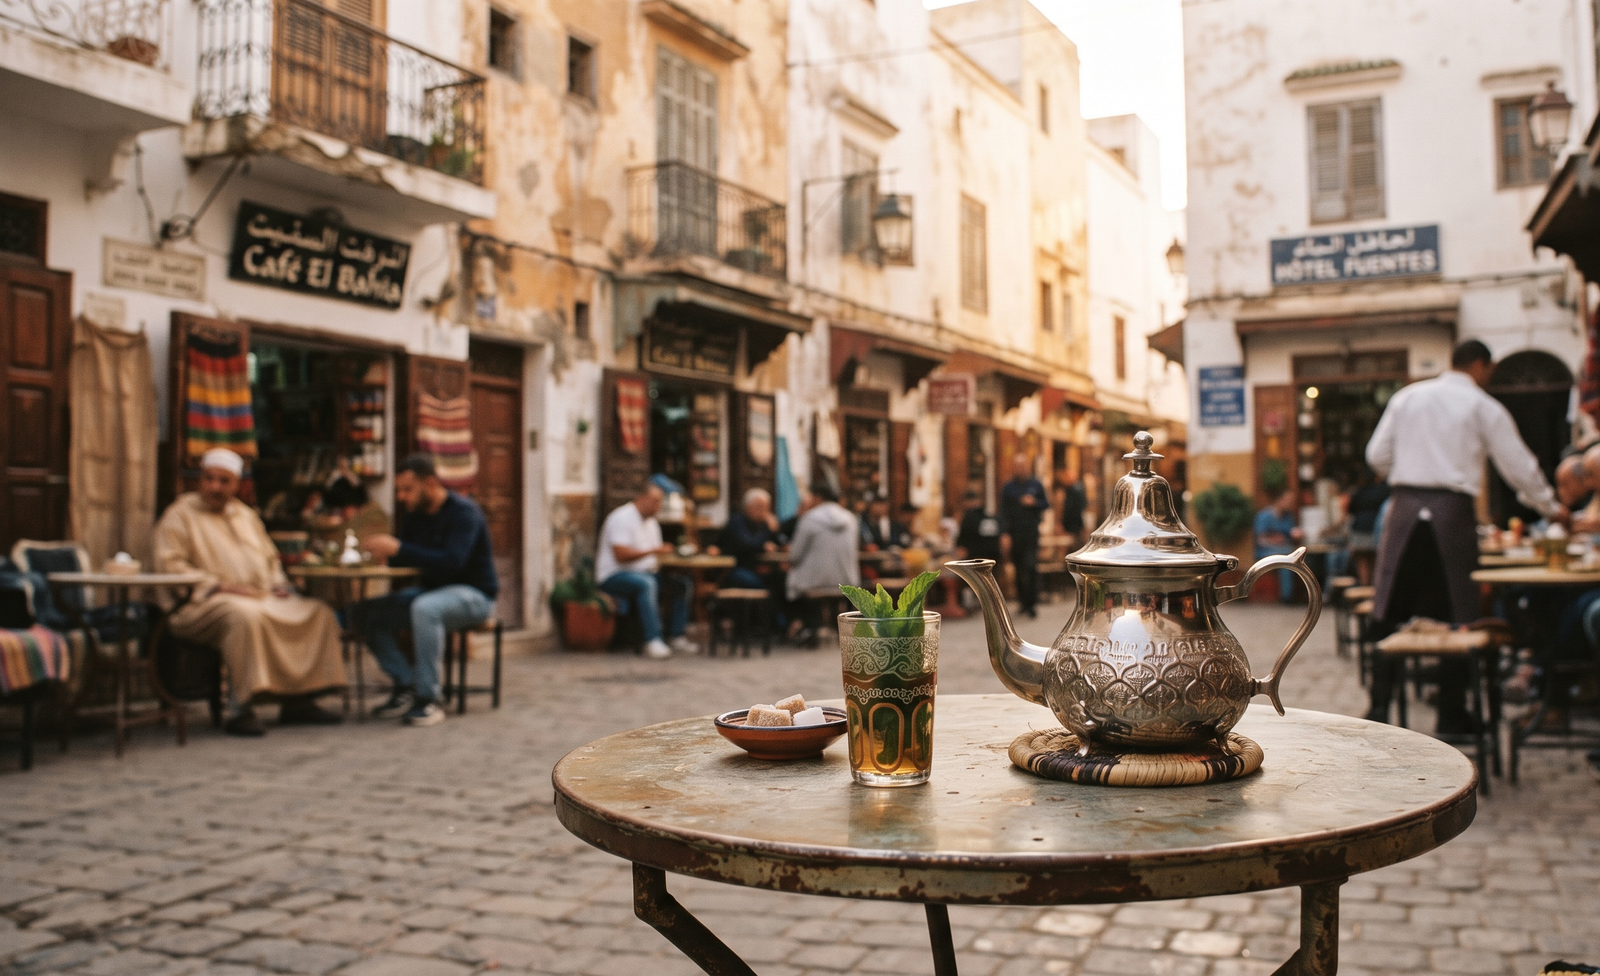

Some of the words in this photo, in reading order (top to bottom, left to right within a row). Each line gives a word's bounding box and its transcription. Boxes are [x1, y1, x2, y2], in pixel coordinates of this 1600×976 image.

[243, 244, 302, 284] Café
[306, 257, 334, 289] El
[1275, 257, 1340, 282] HÔTEL
[1343, 249, 1436, 277] FUENTES
